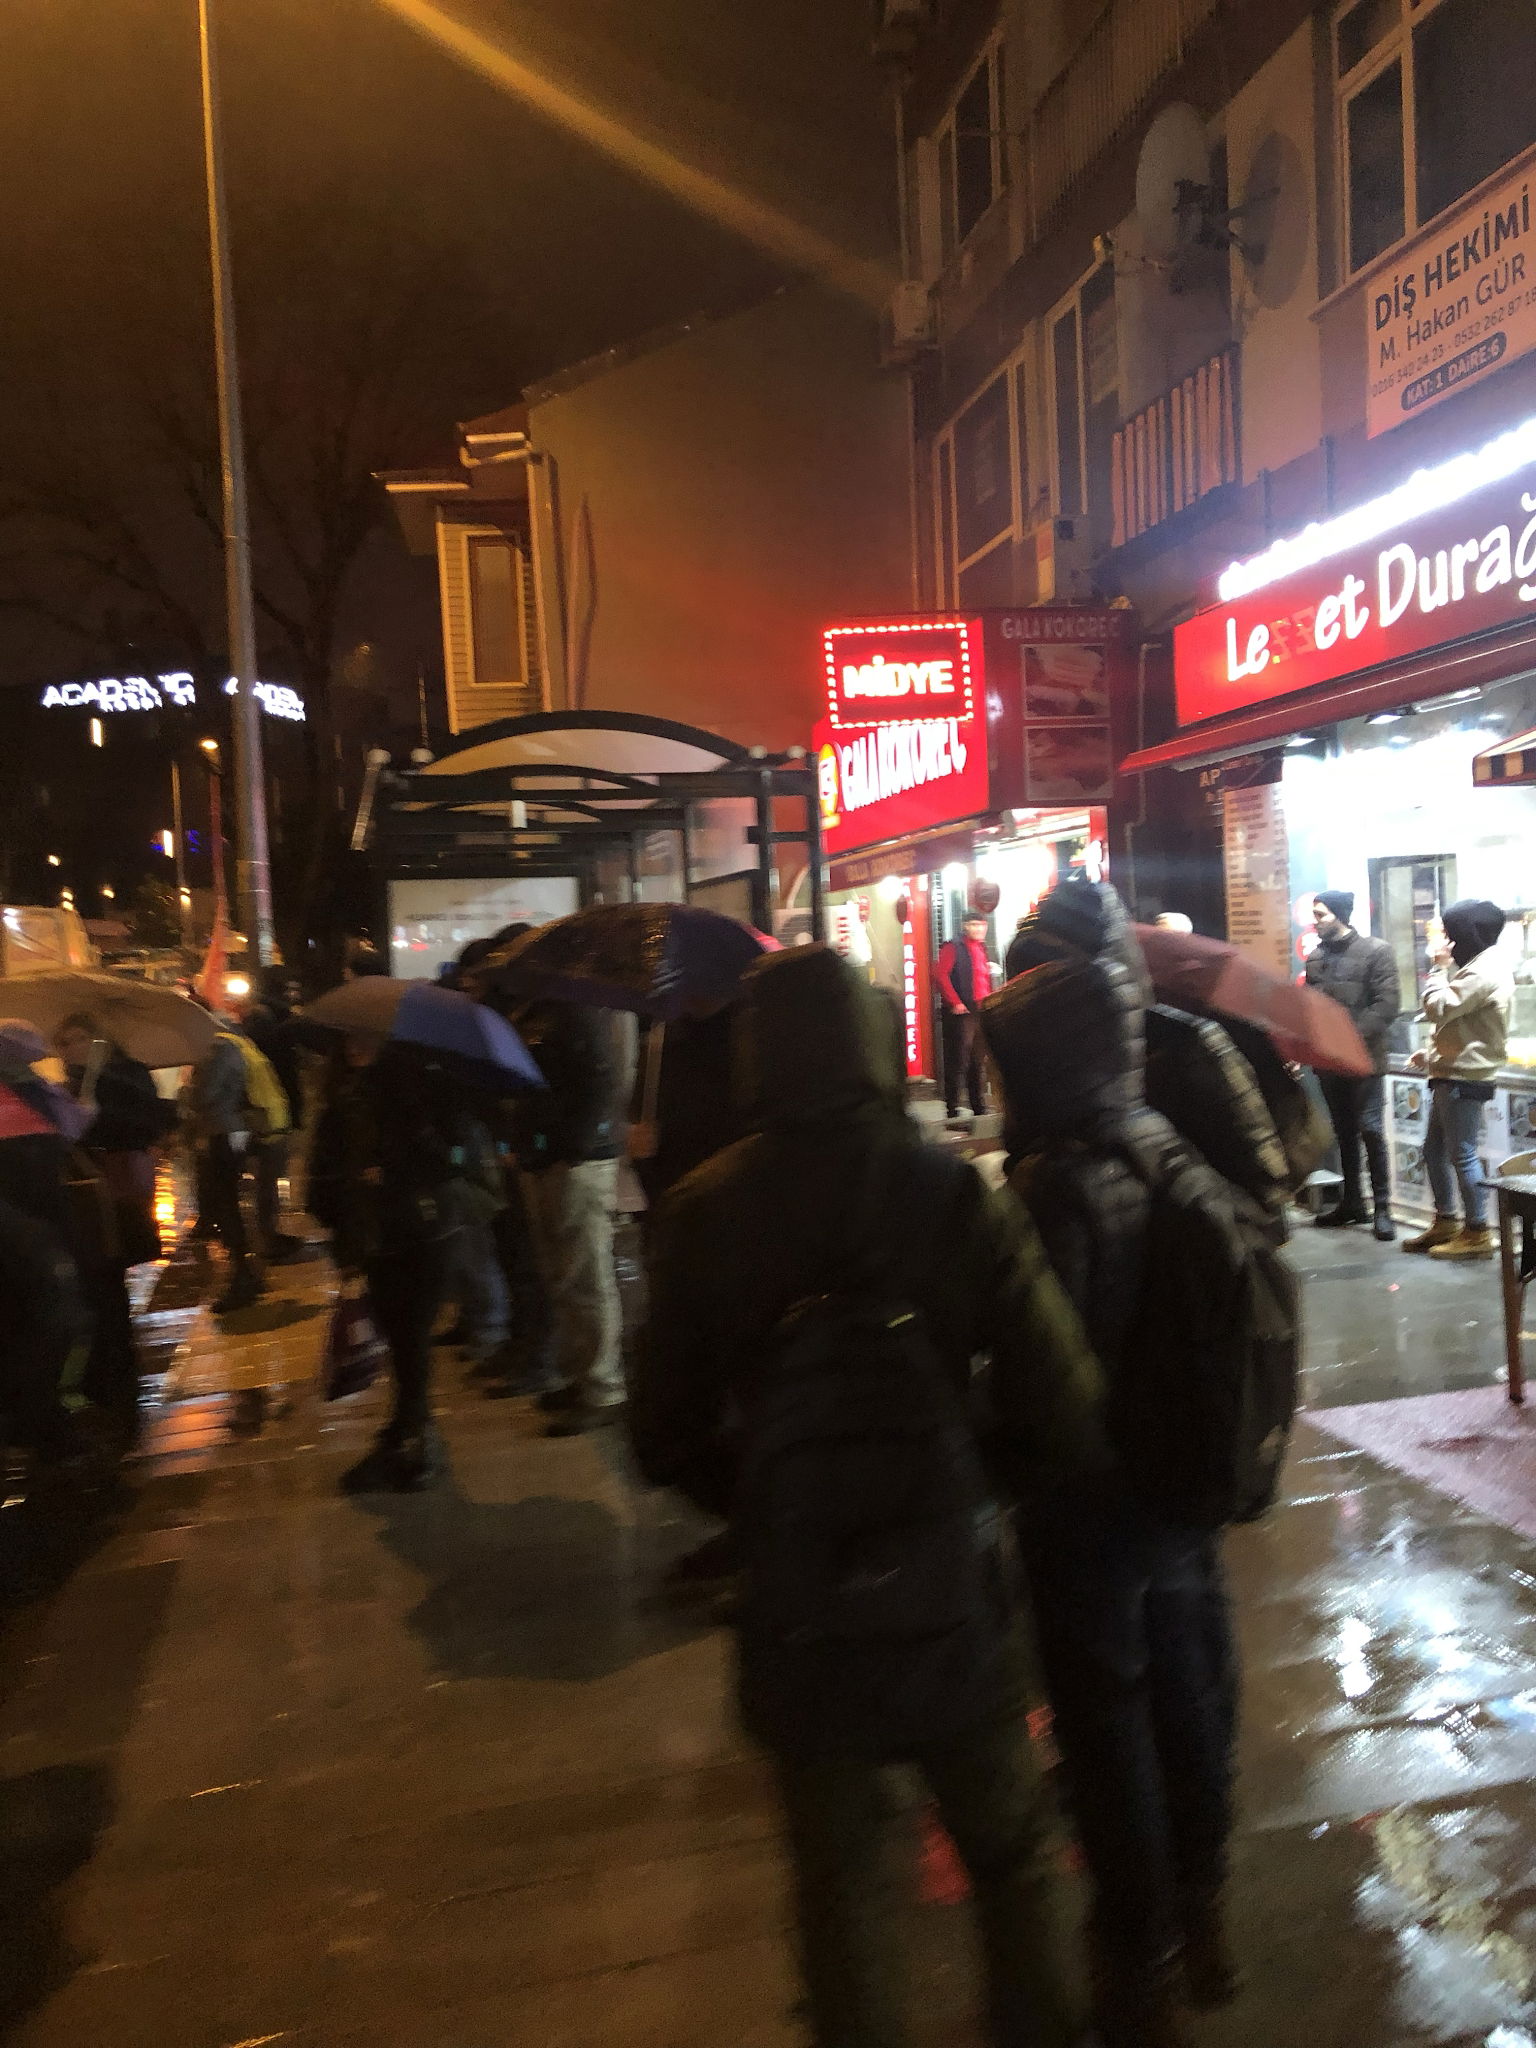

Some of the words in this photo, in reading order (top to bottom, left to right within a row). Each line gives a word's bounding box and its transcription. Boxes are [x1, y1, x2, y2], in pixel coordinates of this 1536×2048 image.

[1375, 273, 1417, 331] DİŞ
[1424, 184, 1530, 298] HEKİMİ
[1380, 337, 1400, 368] M.
[1407, 295, 1470, 350] Hakan
[1475, 252, 1526, 306] GÜR
[843, 655, 955, 698] MİDYE
